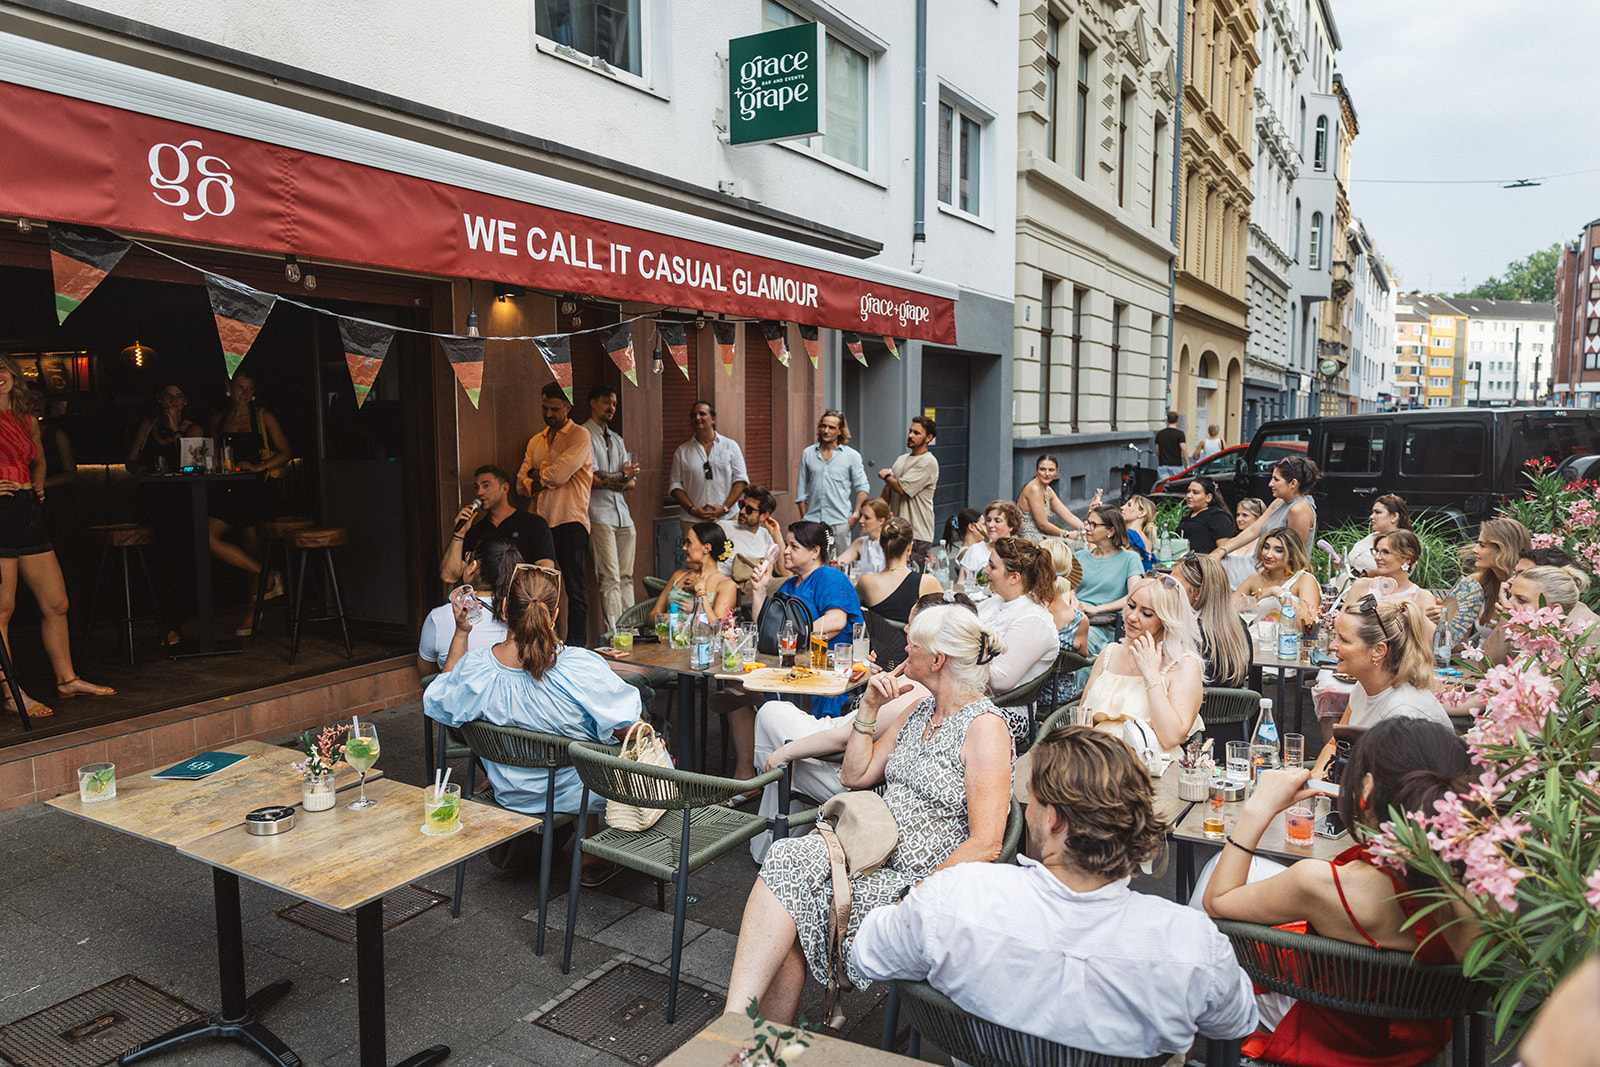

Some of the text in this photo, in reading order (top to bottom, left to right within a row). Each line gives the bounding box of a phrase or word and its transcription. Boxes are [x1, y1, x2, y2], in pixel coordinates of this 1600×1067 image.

[740, 51, 809, 90] grace
[762, 78, 771, 86] BAR
[785, 74, 804, 82] EVENTS
[463, 213, 819, 308] WE CALL IT CASUAL GLAMOUR
